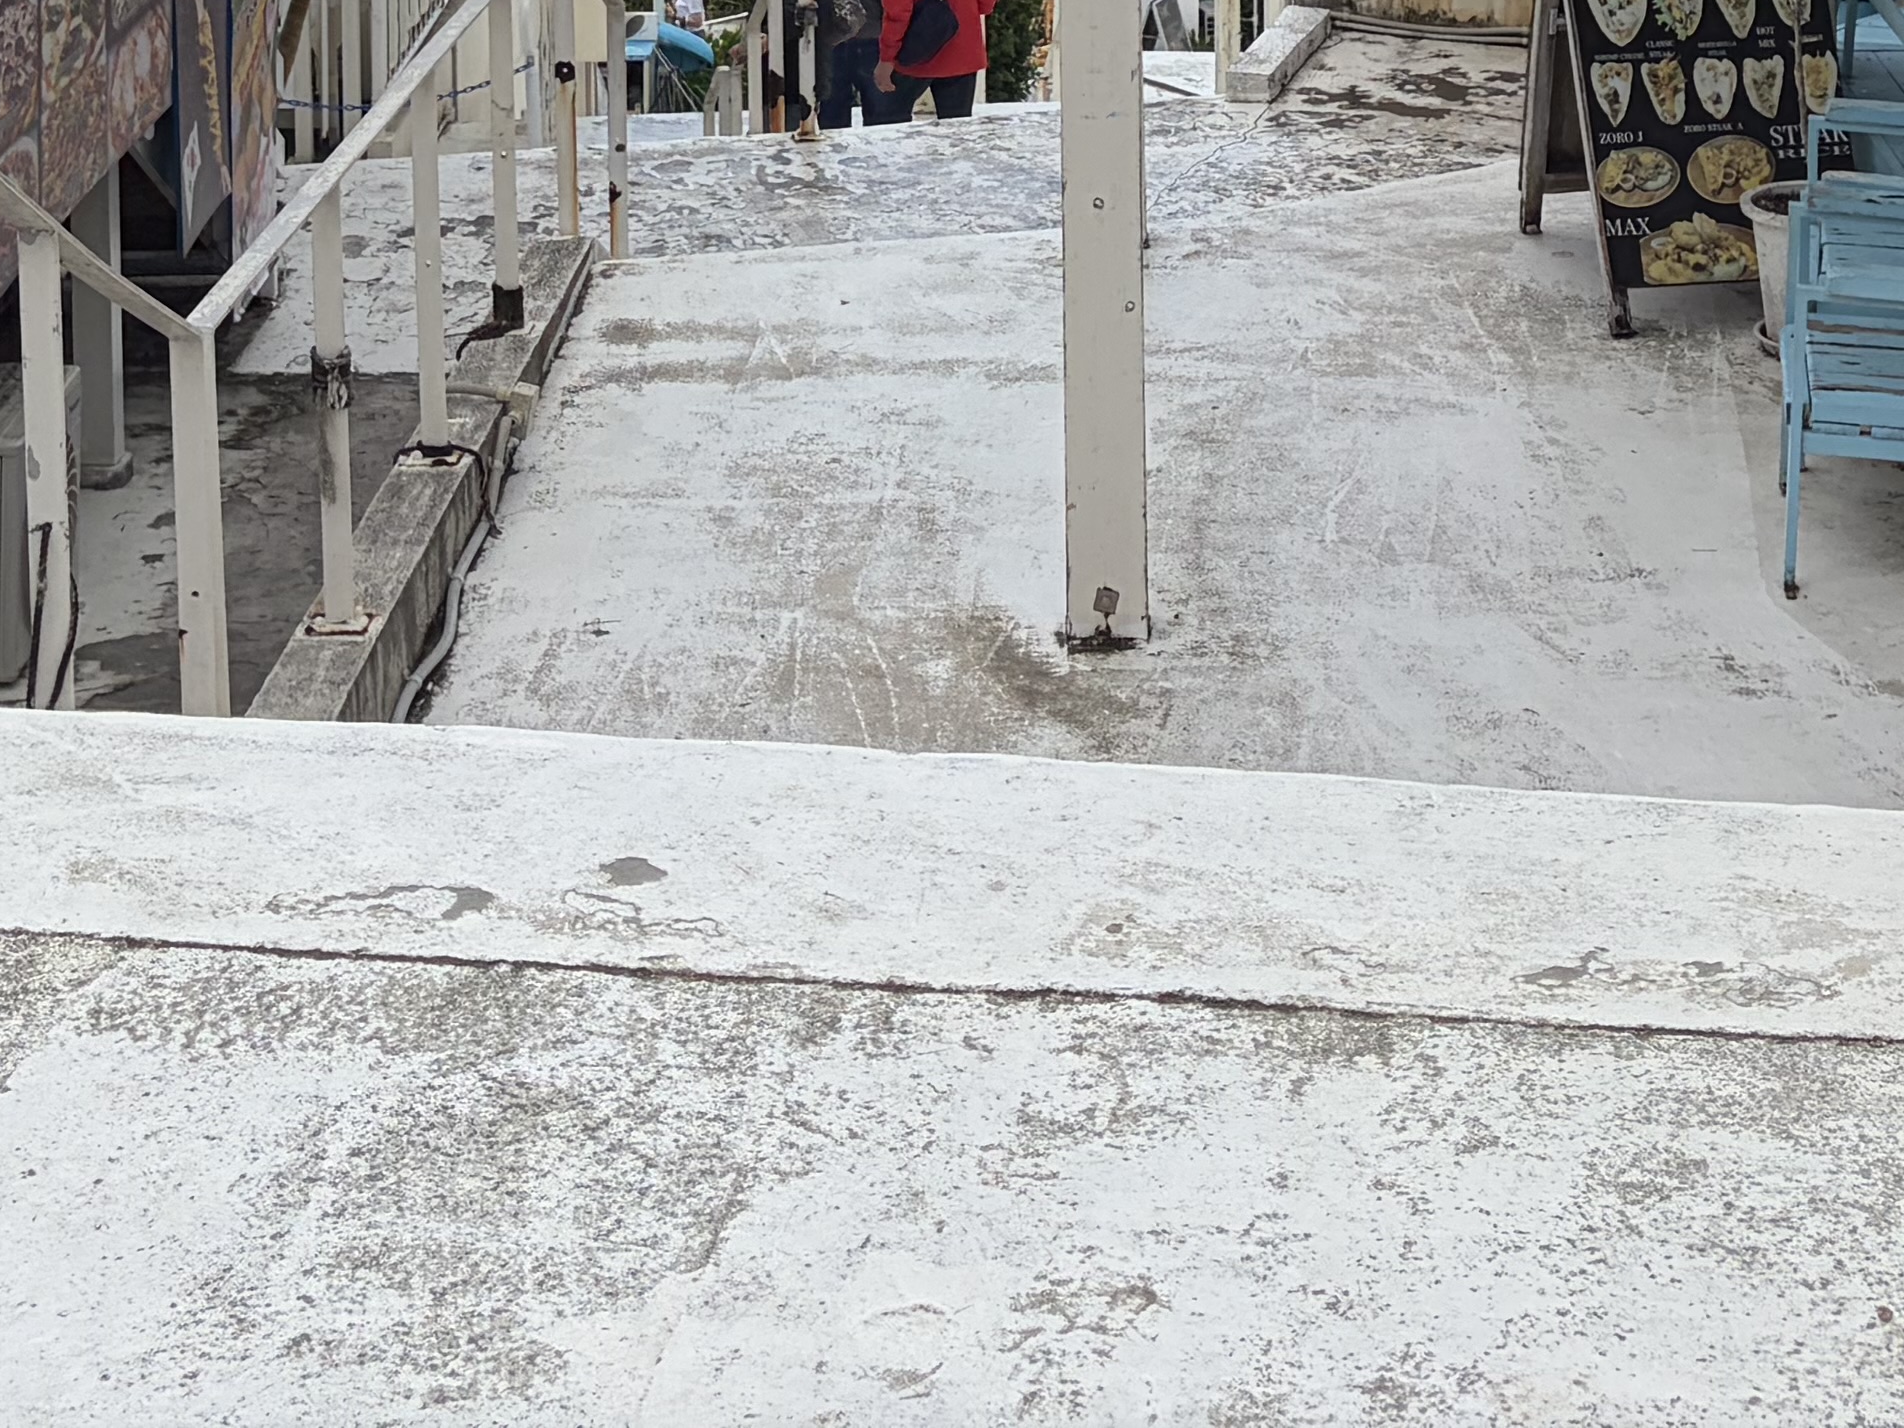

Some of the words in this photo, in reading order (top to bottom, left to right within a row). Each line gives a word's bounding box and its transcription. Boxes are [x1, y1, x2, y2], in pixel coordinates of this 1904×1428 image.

[1599, 131, 1634, 145] ZORO
[1769, 124, 1850, 147] STAK
[1604, 216, 1652, 238] MAX
